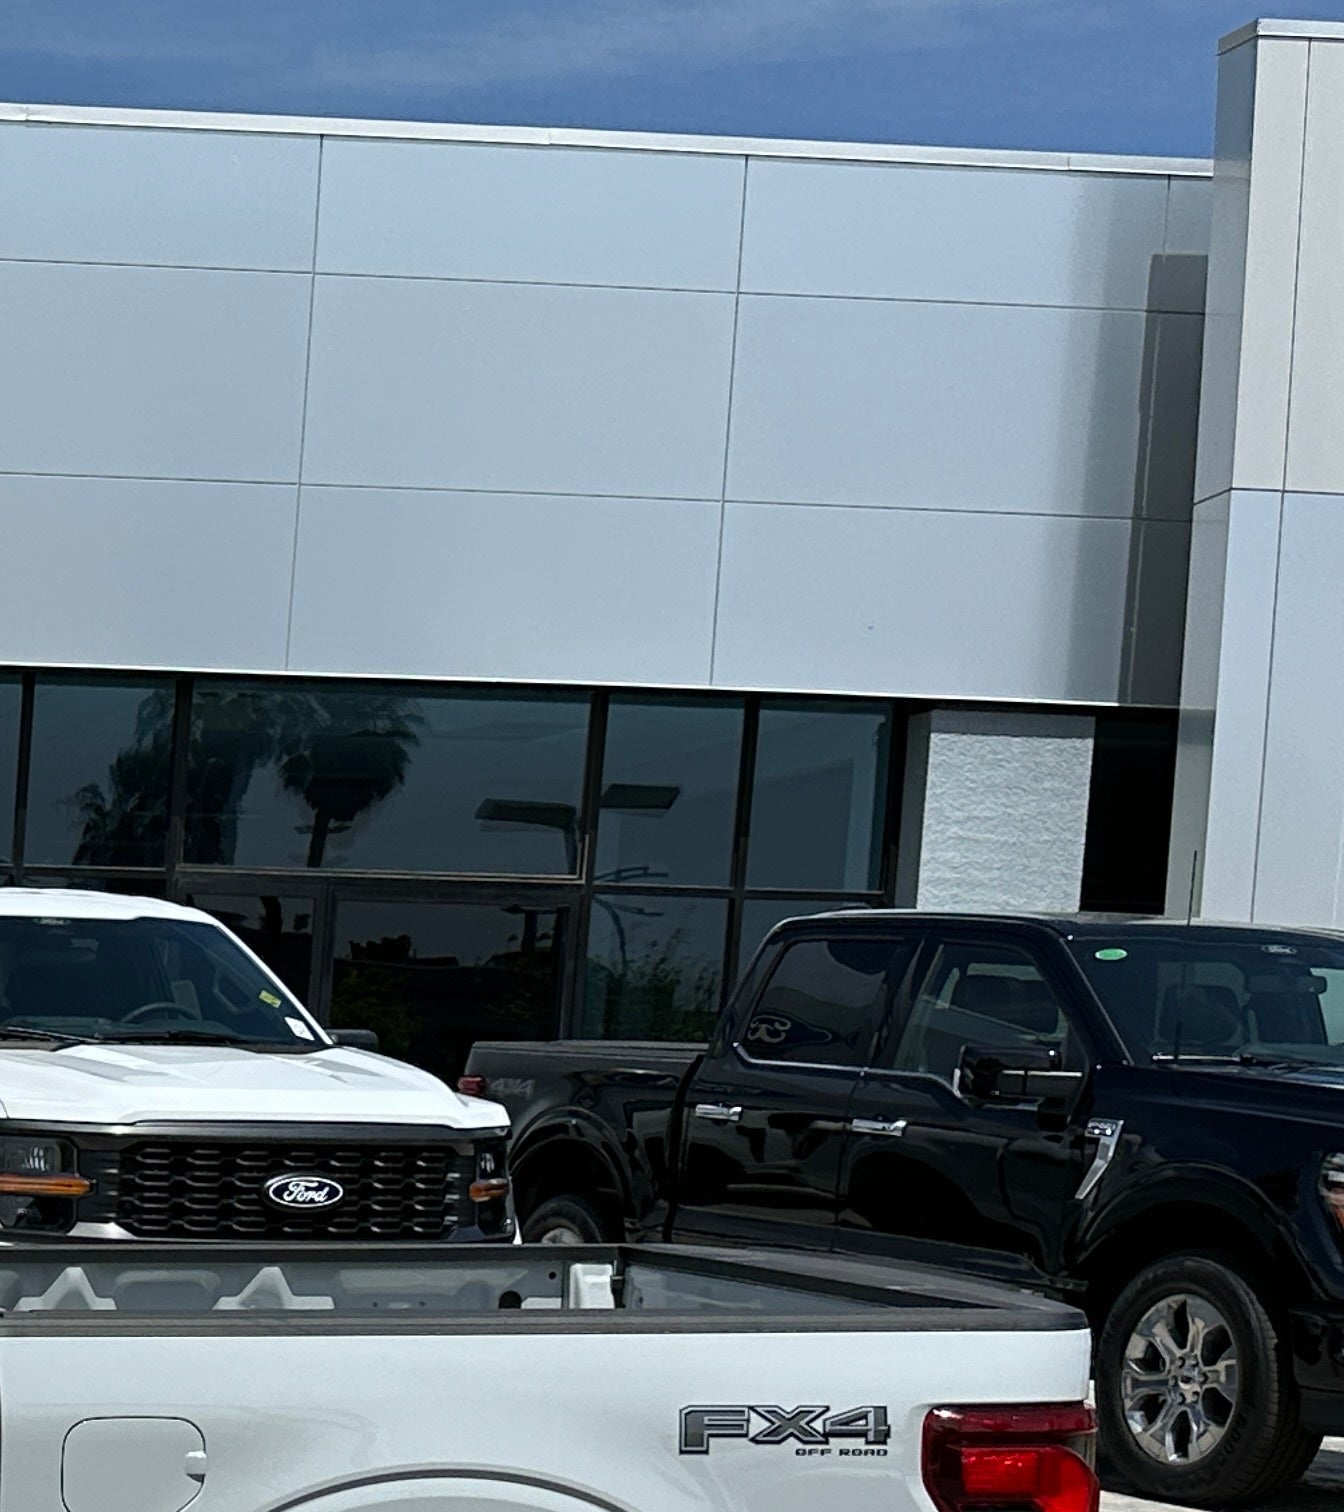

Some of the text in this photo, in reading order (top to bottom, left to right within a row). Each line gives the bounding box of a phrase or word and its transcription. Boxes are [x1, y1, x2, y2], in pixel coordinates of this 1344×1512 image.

[282, 1180, 330, 1202] Ford
[679, 1404, 892, 1456] FX4
[795, 1447, 888, 1457] OFF ROAD
